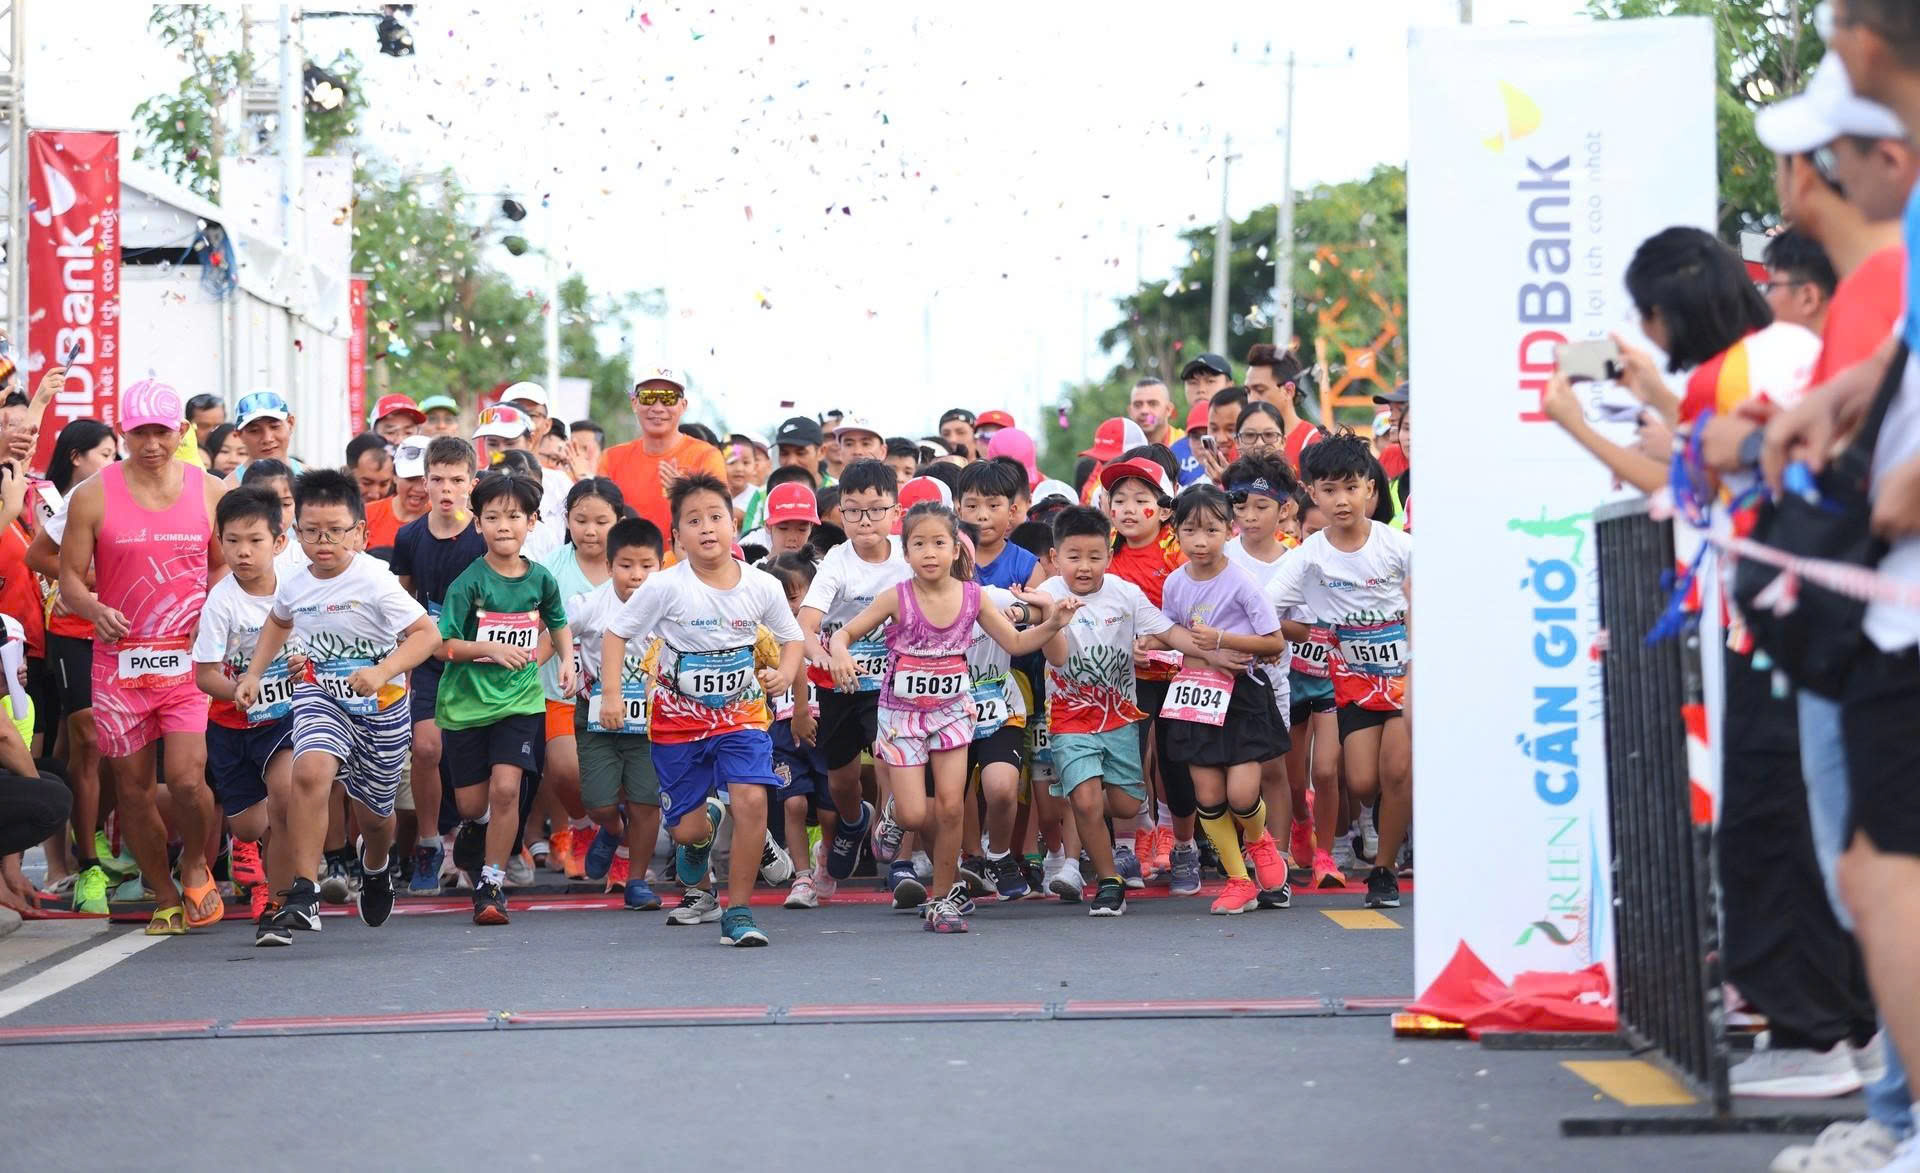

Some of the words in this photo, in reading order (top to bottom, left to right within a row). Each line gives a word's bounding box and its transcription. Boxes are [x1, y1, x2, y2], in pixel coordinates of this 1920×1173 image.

[1517, 155, 1571, 423] HDBank
[153, 533, 203, 542] EXIMBANK
[1520, 557, 1578, 669] GIỜ
[488, 629, 532, 648] 15031
[130, 655, 179, 669] PACER
[1350, 643, 1399, 663] 15141
[322, 678, 370, 699] 1513
[693, 669, 745, 693] 15137
[906, 674, 962, 695] 15037
[1174, 685, 1223, 709] 15034
[1515, 686, 1580, 807] CẦN
